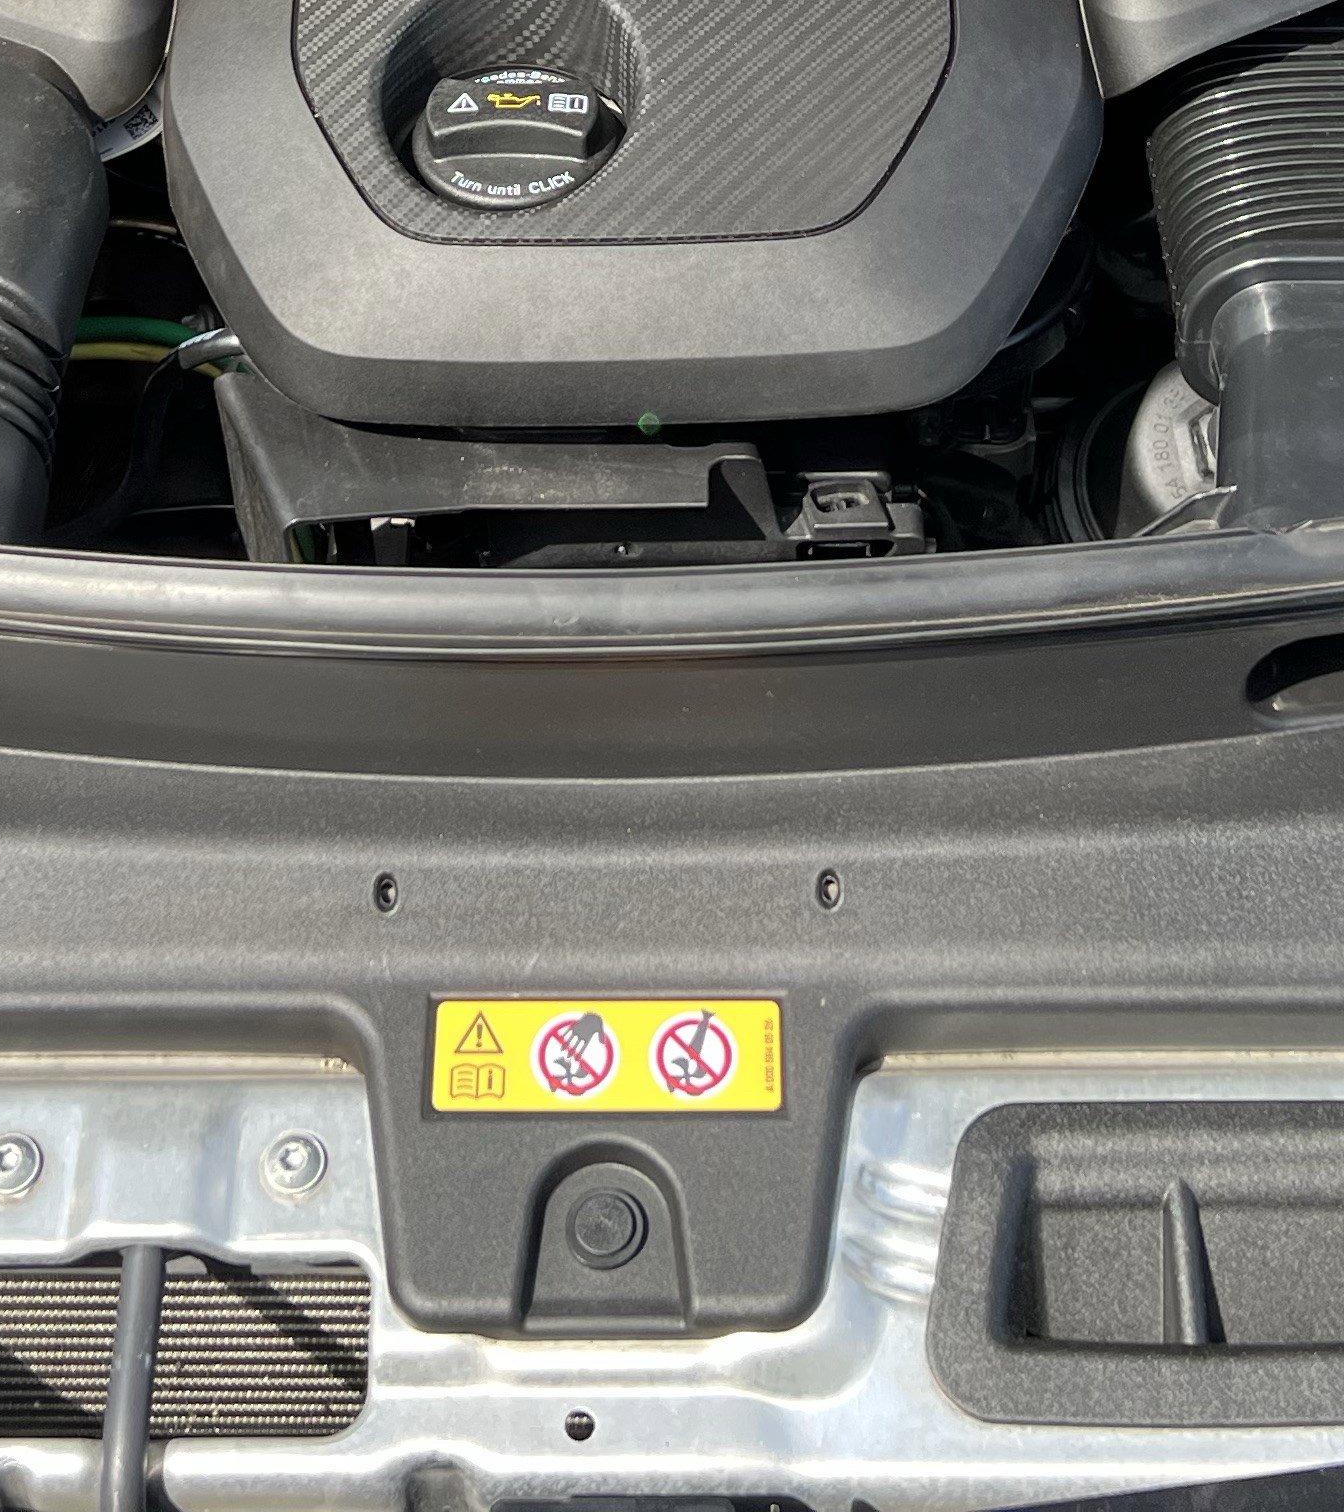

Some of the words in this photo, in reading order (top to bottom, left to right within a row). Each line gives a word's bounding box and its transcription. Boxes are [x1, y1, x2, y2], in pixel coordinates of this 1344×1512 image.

[451, 171, 482, 192] Turn
[487, 183, 522, 196] until
[528, 171, 575, 194] CLICK
[1153, 440, 1172, 472] 180
